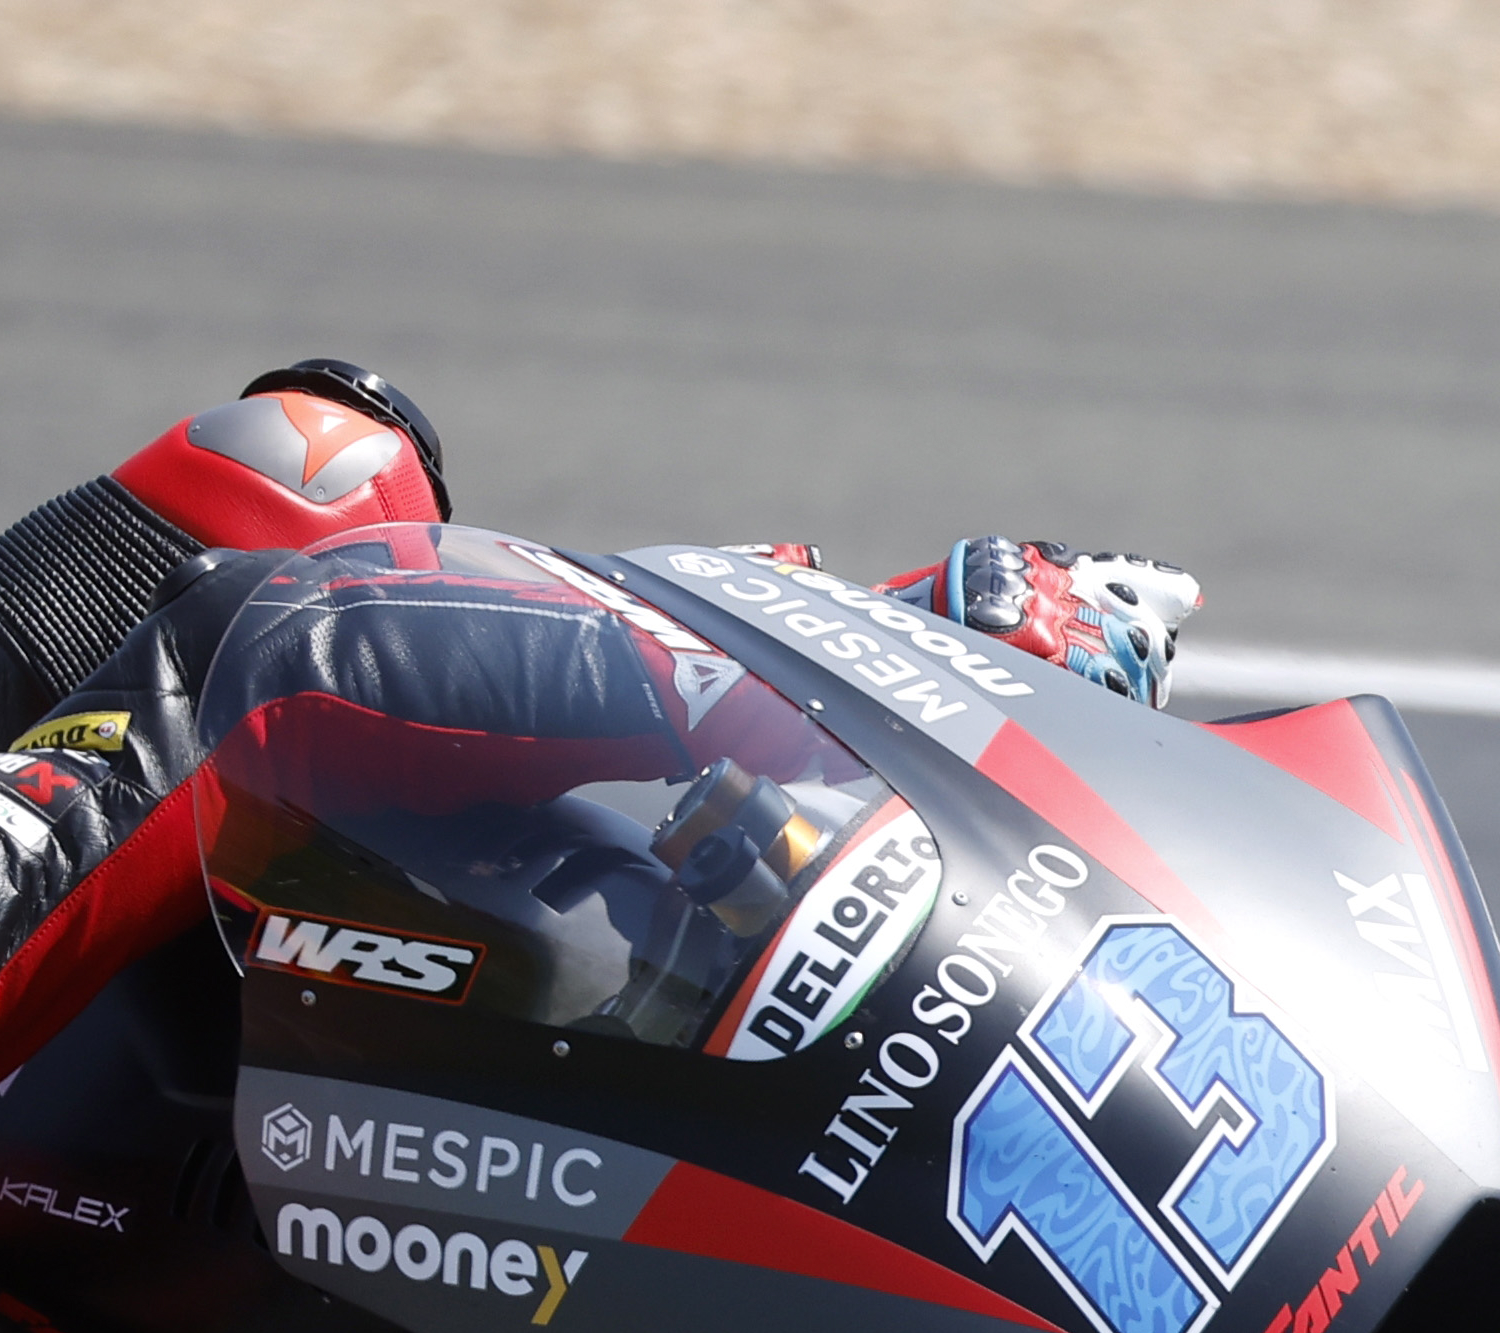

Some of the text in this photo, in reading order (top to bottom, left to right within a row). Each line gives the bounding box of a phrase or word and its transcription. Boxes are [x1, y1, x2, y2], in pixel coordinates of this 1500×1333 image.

[721, 577, 968, 723] MESPIC
[256, 914, 474, 993] WRS
[911, 843, 1089, 1045] SONEGO
[324, 1114, 602, 1208] MESPIC
[797, 1031, 941, 1206] LINO
[0, 1177, 131, 1234] KALEX
[276, 1202, 590, 1326] mooney
